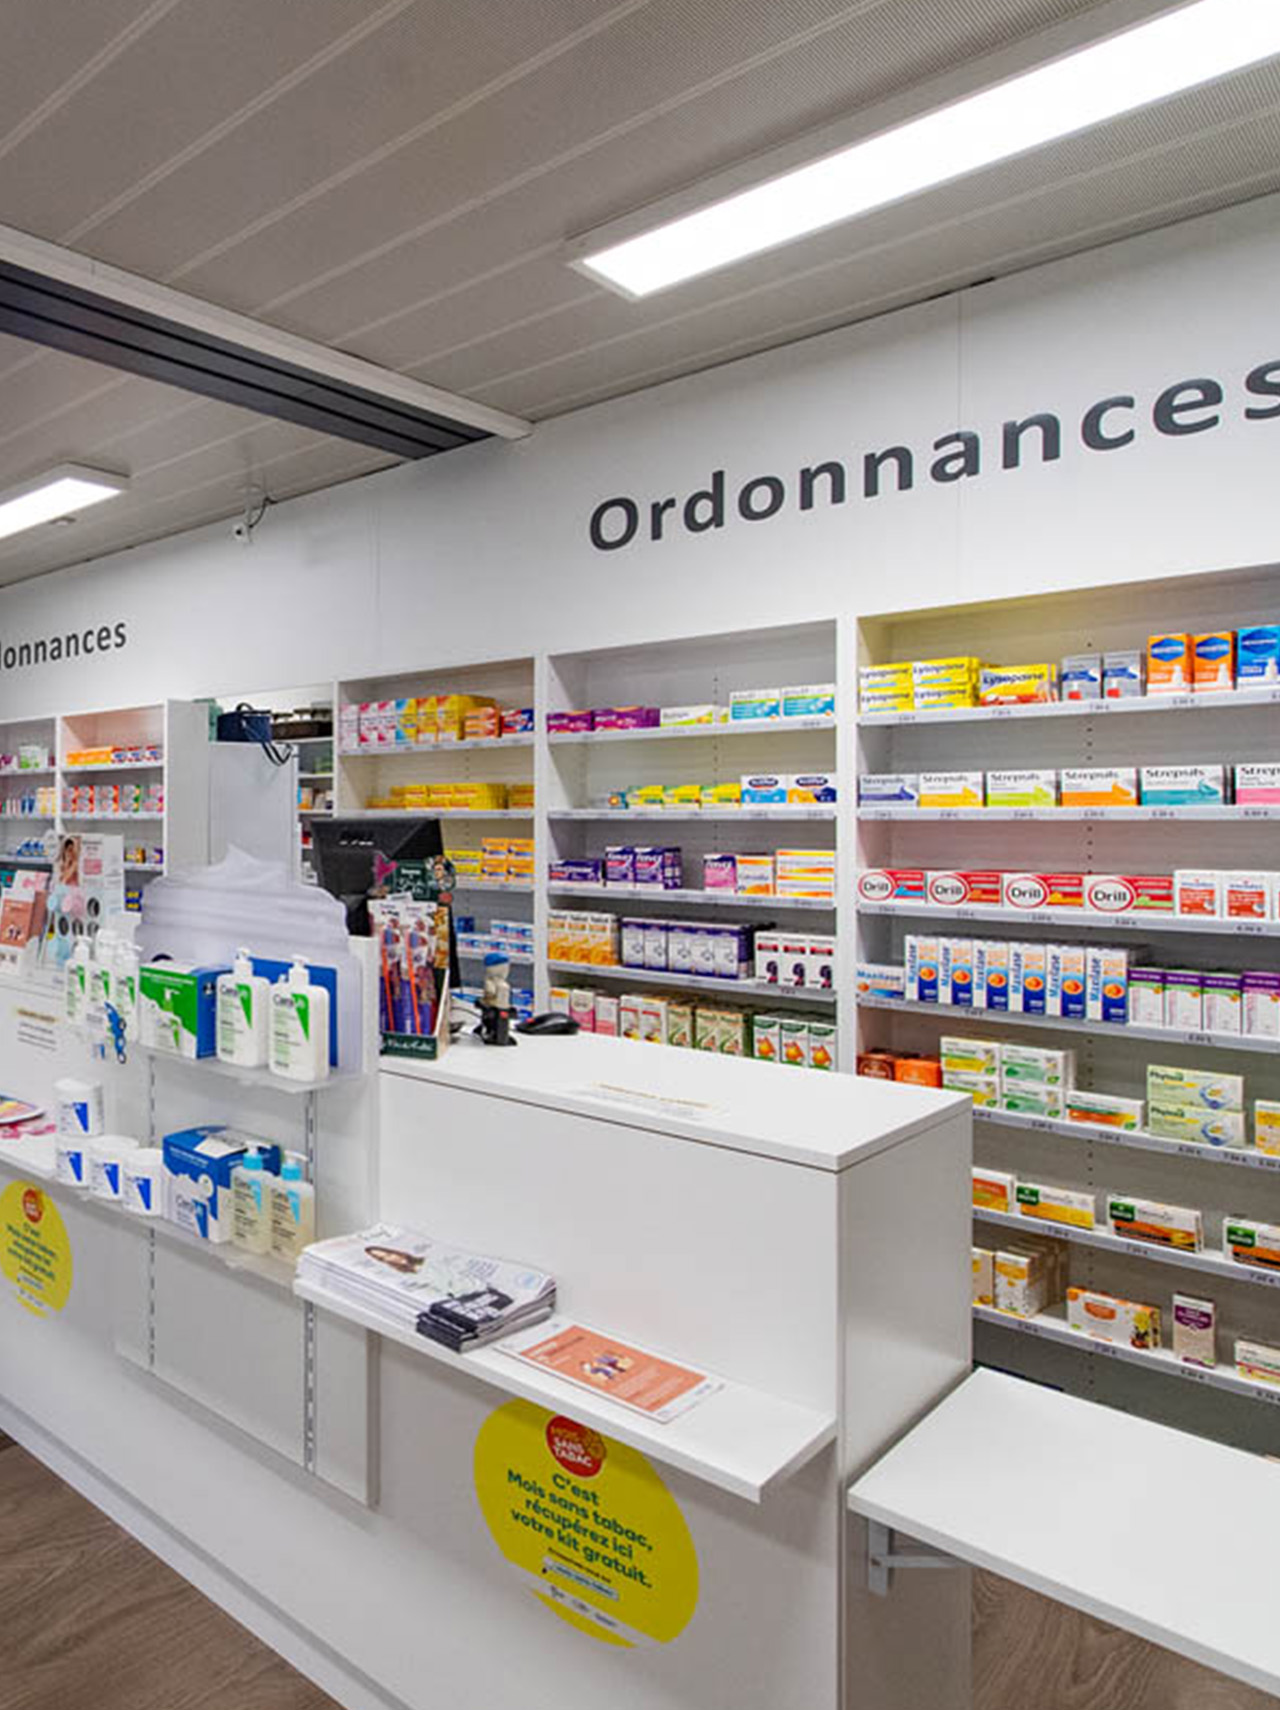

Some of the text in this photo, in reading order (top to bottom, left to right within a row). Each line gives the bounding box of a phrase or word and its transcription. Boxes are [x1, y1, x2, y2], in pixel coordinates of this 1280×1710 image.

[588, 360, 1280, 551] Ordonnances
[863, 881, 889, 891] Drill
[935, 885, 963, 895] Drill
[1011, 887, 1042, 898] Drill
[1094, 890, 1127, 901] Drill
[552, 1473, 599, 1505] C'est
[507, 1469, 653, 1551] Mois sans tabac,
[525, 1499, 633, 1559] récupérez ici
[511, 1508, 554, 1538] votre
[557, 1529, 579, 1551] kit
[582, 1546, 652, 1588] gratuit.
